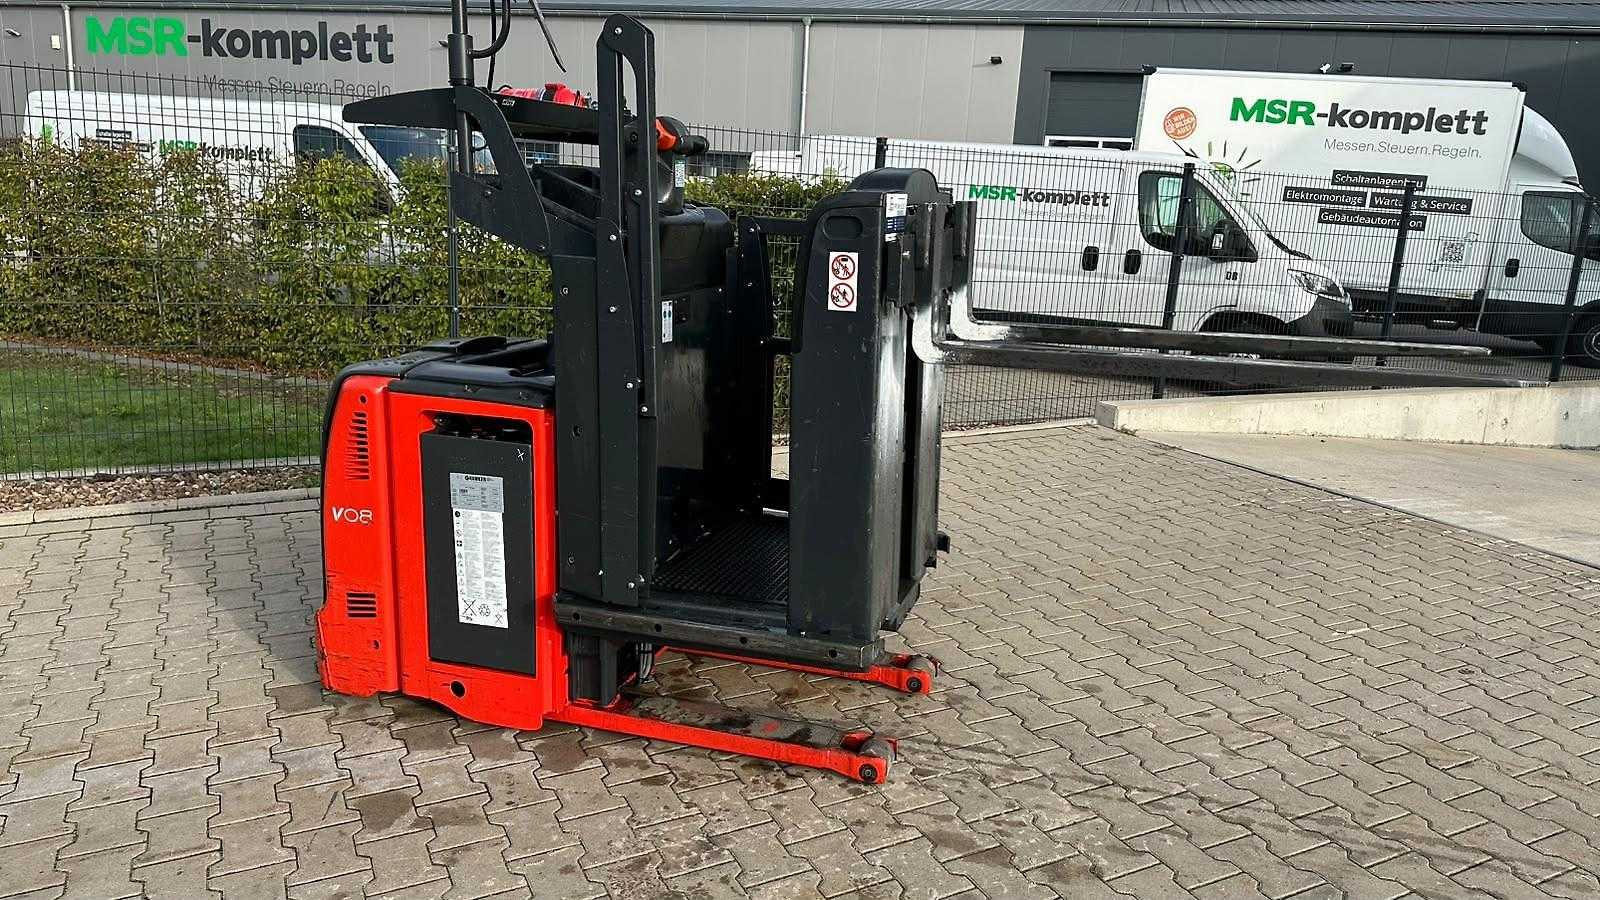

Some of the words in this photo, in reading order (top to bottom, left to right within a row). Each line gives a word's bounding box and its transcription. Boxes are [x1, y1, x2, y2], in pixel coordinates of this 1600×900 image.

[85, 16, 394, 65] MSR-komplett
[1230, 97, 1488, 135] MSR-komplett
[1325, 138, 1482, 159] Messen.Steuern.Regeln.
[1335, 173, 1424, 189] Schaltanlagenu
[968, 184, 1110, 207] MSR-komplett
[1286, 190, 1363, 206] Elektromontage
[1374, 196, 1418, 210] Wartg
[1430, 200, 1468, 212] Service
[1321, 212, 1423, 228] Gebäudeautomon
